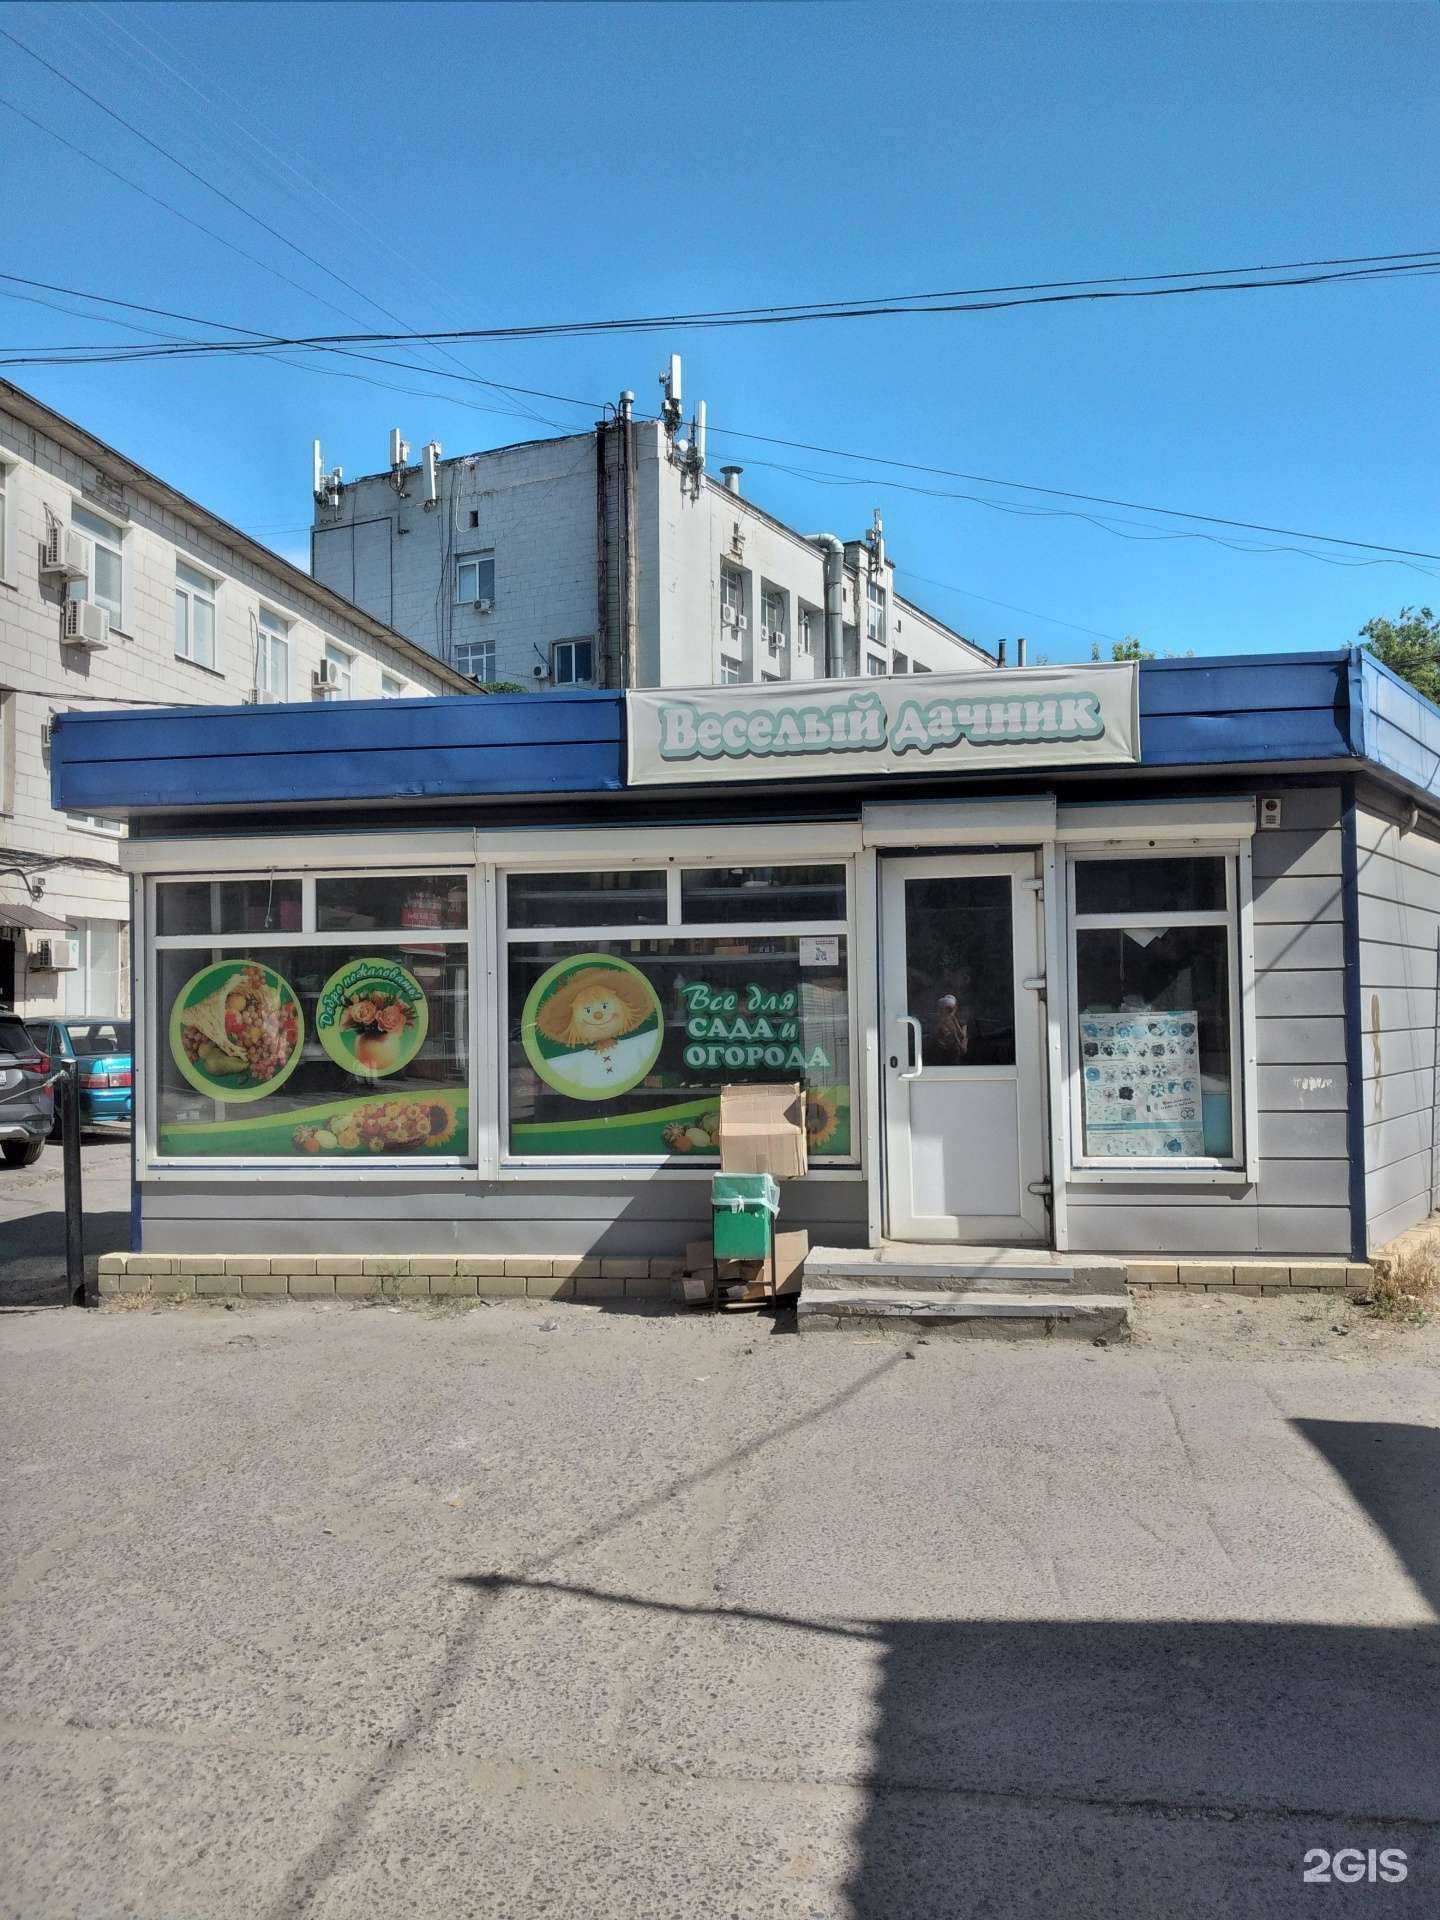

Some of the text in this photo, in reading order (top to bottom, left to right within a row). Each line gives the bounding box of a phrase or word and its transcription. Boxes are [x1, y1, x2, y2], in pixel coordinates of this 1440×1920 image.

[660, 694, 1104, 755] Веселый Дачник
[319, 984, 344, 1028] Добро
[681, 983, 797, 1011] Все для
[688, 1017, 798, 1039] САДА и
[685, 1045, 833, 1069] ОГОРОДА
